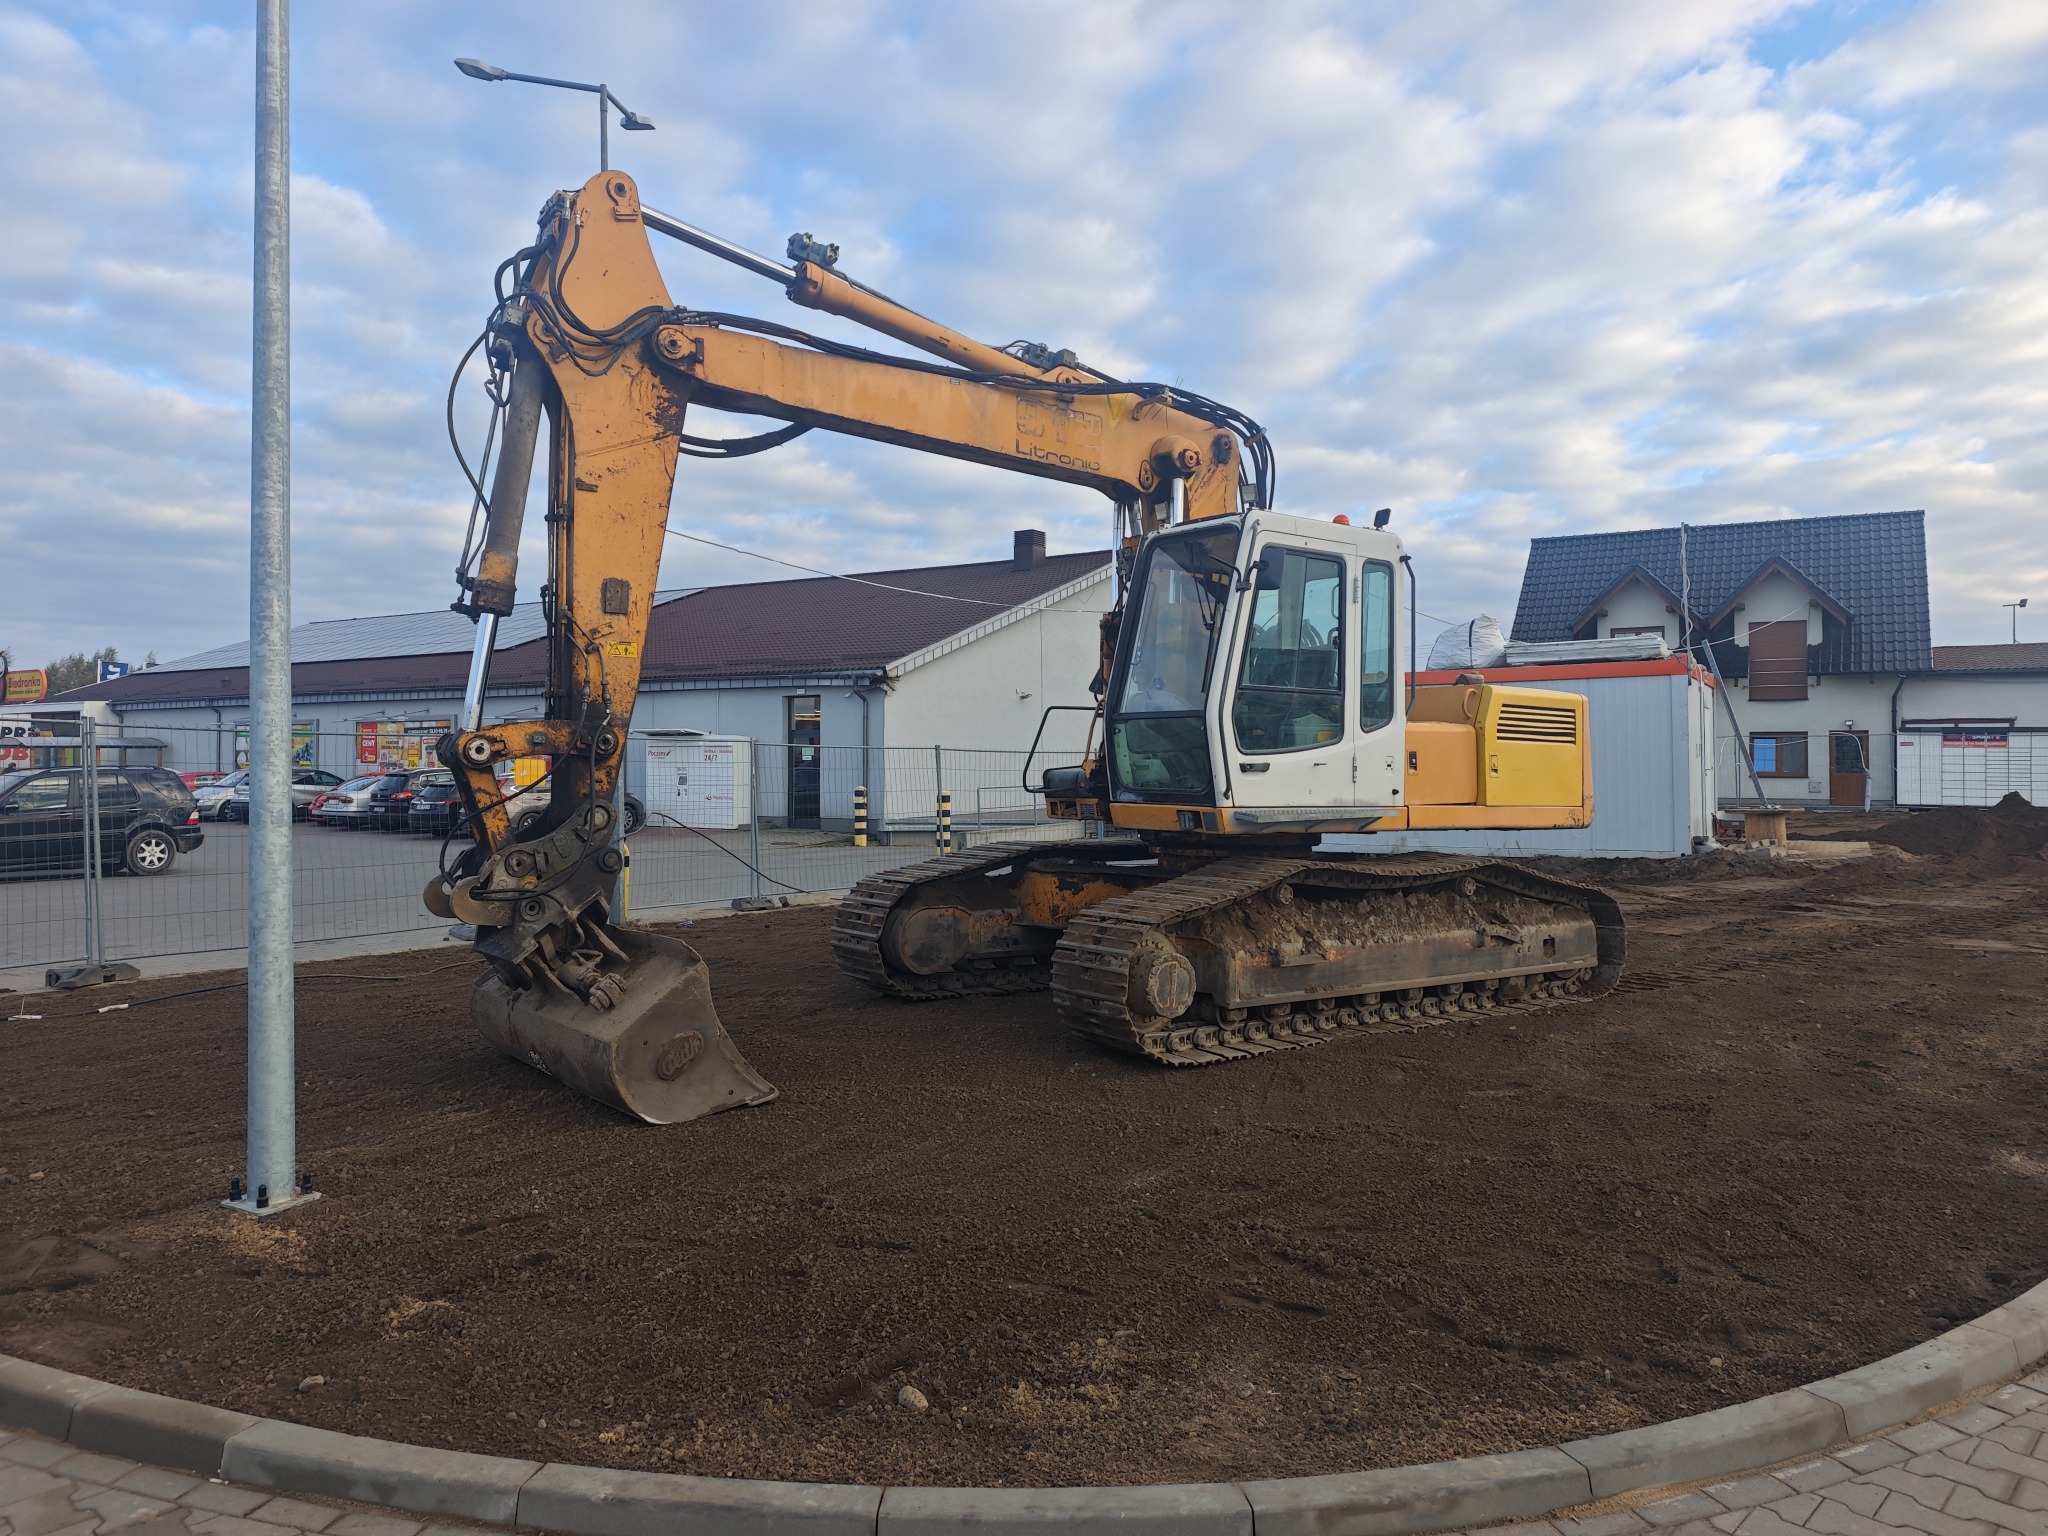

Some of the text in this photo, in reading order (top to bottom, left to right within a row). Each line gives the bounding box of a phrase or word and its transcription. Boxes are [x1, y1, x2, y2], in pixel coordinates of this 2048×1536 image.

[1016, 439, 1101, 471] Litronic
[8, 675, 41, 689] Biedronka
[704, 754, 718, 762] 24/7
